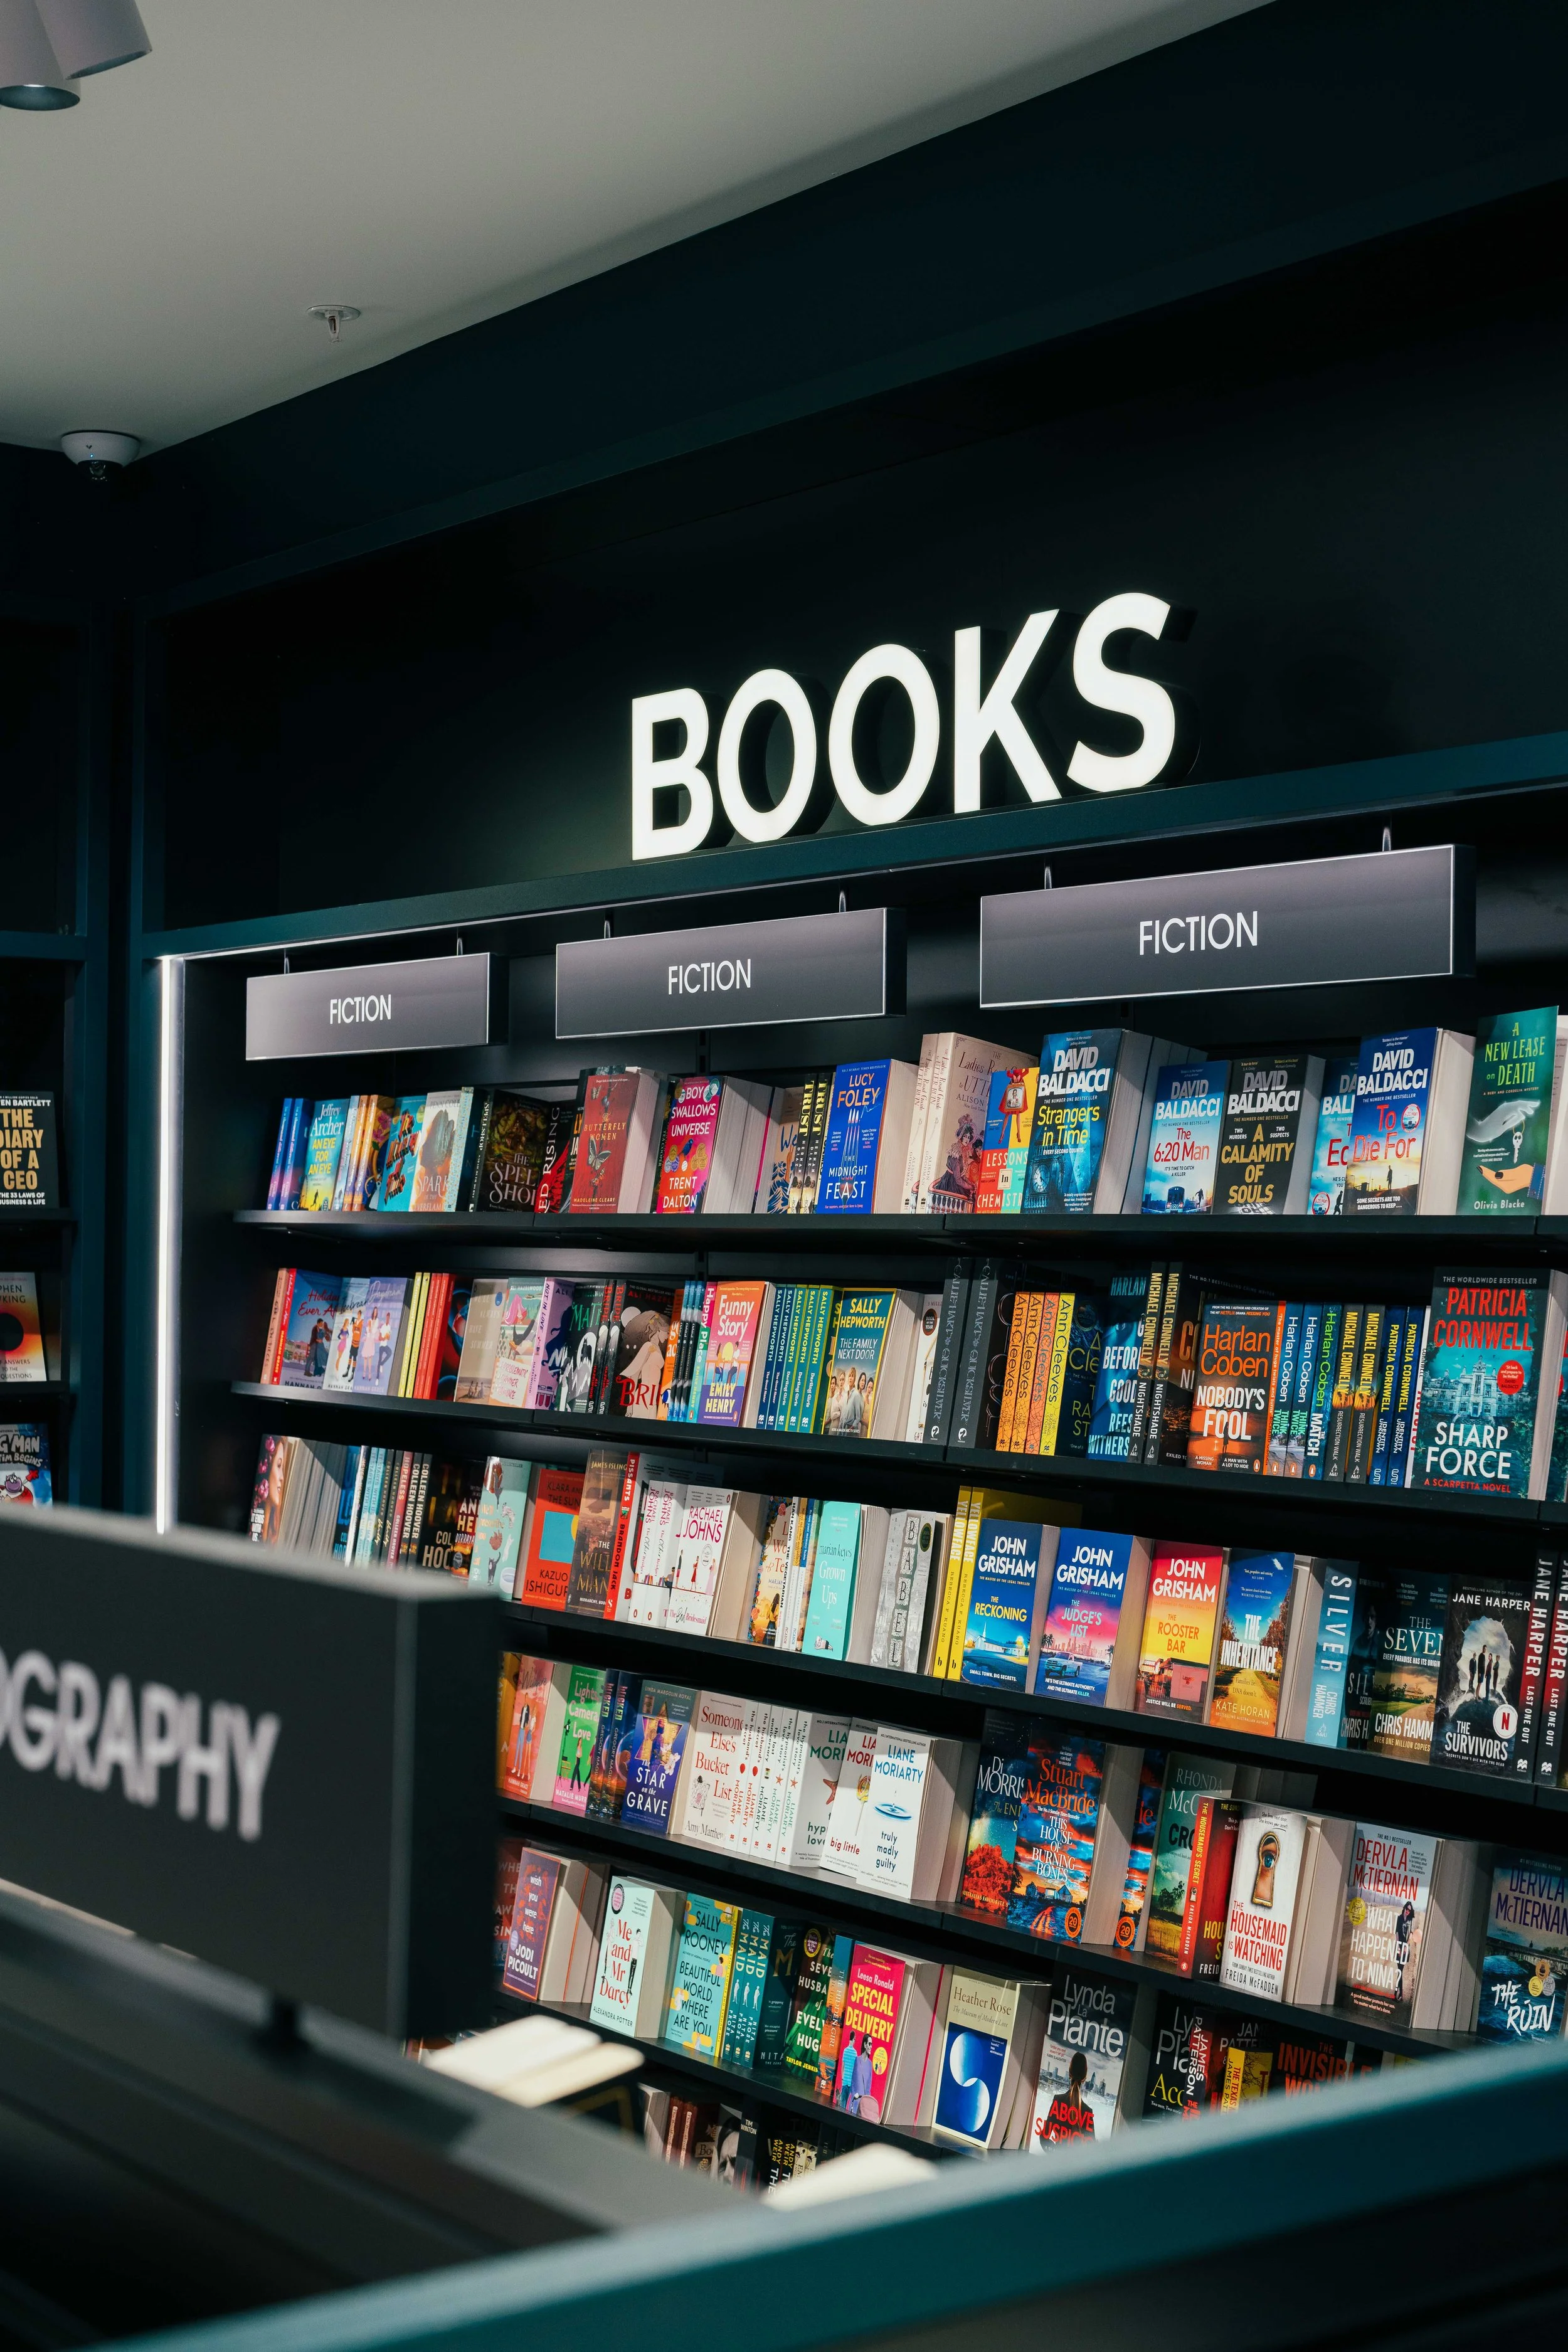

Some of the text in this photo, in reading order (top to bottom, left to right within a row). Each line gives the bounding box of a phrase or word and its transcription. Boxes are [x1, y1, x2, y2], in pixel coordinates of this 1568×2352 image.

[632, 592, 1175, 860] BOOKS
[1140, 911, 1258, 955] FICTION
[668, 958, 751, 995] FICTION
[330, 994, 392, 1024] FICTION
[1512, 1022, 1519, 1036] A
[1054, 1047, 1099, 1072] DAVID
[1485, 1036, 1545, 1062] NEW LEASE
[849, 1073, 874, 1087] LUCY
[1038, 1068, 1110, 1096] BALDACCI
[1243, 1070, 1288, 1093] DAVID
[1497, 1062, 1535, 1086] DEATH
[686, 1088, 704, 1099] BOY
[837, 1088, 880, 1107] FOLEY
[1227, 1090, 1300, 1115] BALDACCI
[0, 1108, 34, 1128] THE
[319, 1103, 341, 1121] Jeffrey
[671, 1103, 716, 1119] SWALLOWS
[1037, 1105, 1099, 1128] Strangers
[311, 1118, 344, 1137] Archer
[584, 1123, 626, 1131] BUTTERFLY
[590, 1133, 617, 1141] WOMEN
[671, 1122, 710, 1136] UNIVERSE
[1042, 1126, 1088, 1147] in Time
[1253, 1124, 1264, 1142] A
[313, 1138, 335, 1149] AN EYE
[1222, 1142, 1295, 1163] CALAMITY
[1, 1150, 39, 1169] OF A
[315, 1152, 328, 1162] FOR
[3, 1170, 38, 1190] CEO
[309, 1163, 331, 1175] AN EYE
[829, 1165, 867, 1177] MIDNIGHT
[1244, 1165, 1264, 1184] OF
[669, 1177, 697, 1189] TRENT
[826, 1181, 866, 1199] FEAST
[1227, 1184, 1274, 1204] SOULS
[663, 1195, 697, 1209] DALTON
[1474, 1199, 1525, 1210] Olivia Blacke
[718, 1295, 755, 1320] Funny
[850, 1298, 882, 1313] SALLY
[1446, 1287, 1527, 1316] PATRICIA
[718, 1316, 748, 1342] Story
[840, 1316, 885, 1328] HEPWORTH
[1140, 1273, 1162, 1363] MICHAEL CONNELLY
[840, 1338, 877, 1348] THE FAMILY
[1204, 1324, 1270, 1352] Harlan
[1434, 1320, 1533, 1352] CORNWELL
[838, 1349, 874, 1360] NEXT DOOR
[1049, 1299, 1071, 1402] Ann Cleeves
[1200, 1349, 1267, 1377] Coben
[709, 1382, 735, 1397] EMILY
[1197, 1385, 1265, 1410] NOBODY'S
[706, 1399, 735, 1413] HENRY
[1133, 1382, 1147, 1437] NIGHTSHADE
[1203, 1409, 1251, 1440] FOOL
[1435, 1421, 1508, 1449] SHARP
[1426, 1447, 1512, 1479] FORCE
[1424, 1478, 1511, 1493] A SCARPETTA NOVEL
[689, 1506, 723, 1523] RACHAEL
[683, 1520, 723, 1544] JOHNS
[991, 1536, 1027, 1555] JOHN
[1072, 1545, 1113, 1567] JOHN
[978, 1554, 1036, 1578] GRISHAM
[1057, 1564, 1124, 1590] GRISHAM
[974, 1602, 1027, 1622] RECKONING
[1453, 1593, 1530, 1612] JANE HARPER
[1062, 1608, 1102, 1625] JUDGE'S
[1245, 1614, 1261, 1641] THE
[1321, 1576, 1352, 1672] SILVER
[1071, 1624, 1088, 1638] LIST
[1221, 1640, 1279, 1673] INHERITANCE
[1216, 1700, 1270, 1719] KATE HORAN
[1457, 1720, 1471, 1736] THE
[0, 1646, 280, 1843] GRAPHY
[888, 1744, 916, 1764] LIANE
[1444, 1732, 1508, 1761] SURVIVORS
[874, 1760, 923, 1783] MORIARTY
[1040, 1758, 1085, 1789] Stuart
[1025, 1779, 1095, 1816] MacBride
[1049, 1815, 1067, 1831] THIS
[882, 1831, 898, 1843] truly
[1041, 1826, 1073, 1845] HOUSE
[877, 1843, 898, 1859] madly
[1032, 1847, 1075, 1870] BURNING
[1051, 1842, 1061, 1853] OF
[1357, 1837, 1407, 1872] DERVLA
[876, 1858, 896, 1873] guilty
[1036, 1862, 1068, 1883] BONES
[1234, 1900, 1244, 1911] THE
[618, 1919, 632, 1941] Me
[696, 1910, 721, 1932] SALLY
[1231, 1911, 1287, 1946] HOUSEMAID
[1366, 1907, 1399, 1935] WHAT
[515, 1944, 534, 1962] JODI
[612, 1943, 631, 1962] and
[684, 1930, 727, 1955] ROONEY
[1351, 1929, 1410, 1965] HAPPENED
[1234, 1937, 1283, 1972] WATCHING
[508, 1955, 538, 1980] PICOULT
[610, 1961, 625, 1982] Mr
[679, 1961, 721, 1987] BEAUTIFUL
[1226, 1969, 1247, 1986] FREIDA
[1352, 1956, 1402, 1991] TO NINA?
[857, 1968, 894, 1990] Leesa Ronald
[600, 1977, 631, 2010] Darcy
[684, 1979, 713, 2004] WORLD,
[851, 1982, 893, 2016] SPECIAL
[953, 1986, 1012, 2015] Heather Rose
[1064, 1975, 1116, 2015] Lynda
[1491, 1981, 1522, 2007] THE
[682, 1997, 709, 2019] WHERE
[1078, 2004, 1087, 2017] La
[674, 2014, 711, 2037] ARE YOU
[845, 2006, 893, 2042] DELIVERY
[1047, 1998, 1124, 2057] Plante
[1049, 2100, 1094, 2131] ABOVE
[741, 2124, 757, 2134] WINTON
